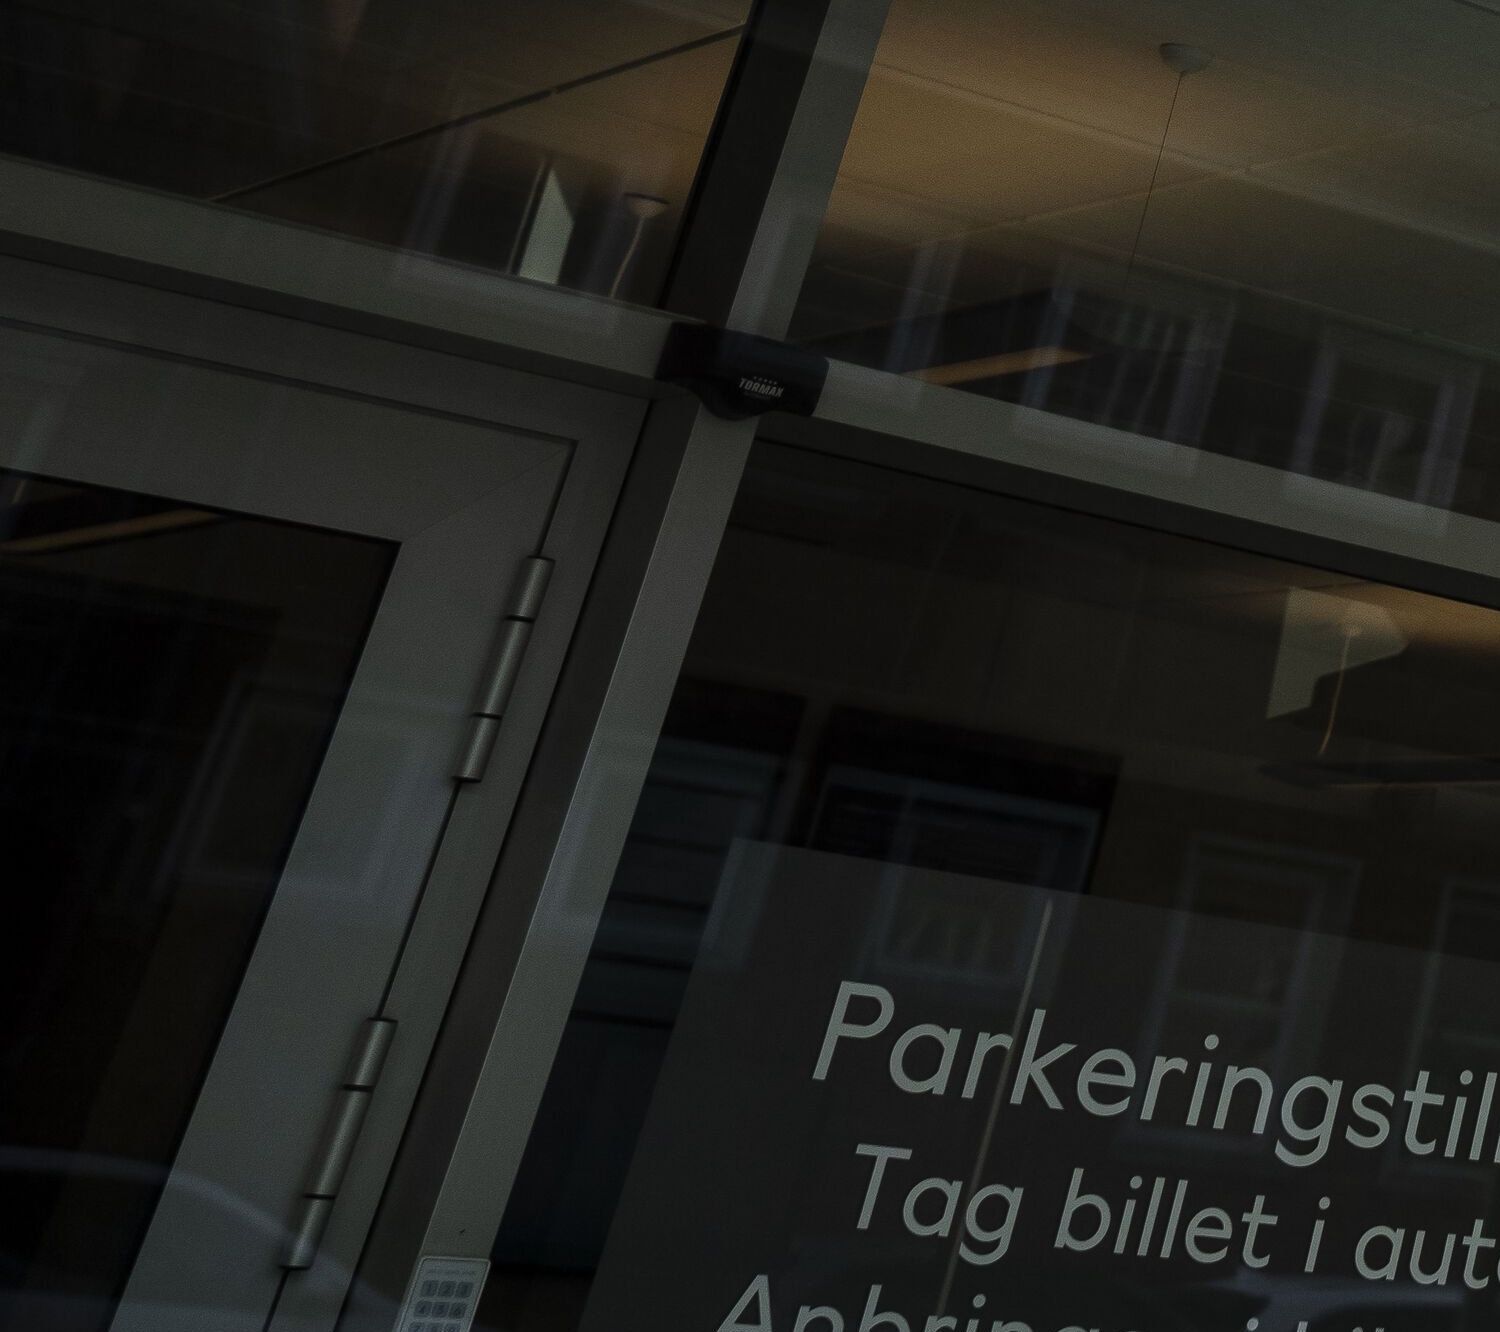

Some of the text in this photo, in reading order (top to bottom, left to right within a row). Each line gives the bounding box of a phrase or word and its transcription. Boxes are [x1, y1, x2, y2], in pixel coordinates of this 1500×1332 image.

[738, 377, 781, 398] TORMAX
[854, 1142, 1025, 1266] Tag
[1053, 1167, 1280, 1269] billet
[1303, 1196, 1332, 1273] i
